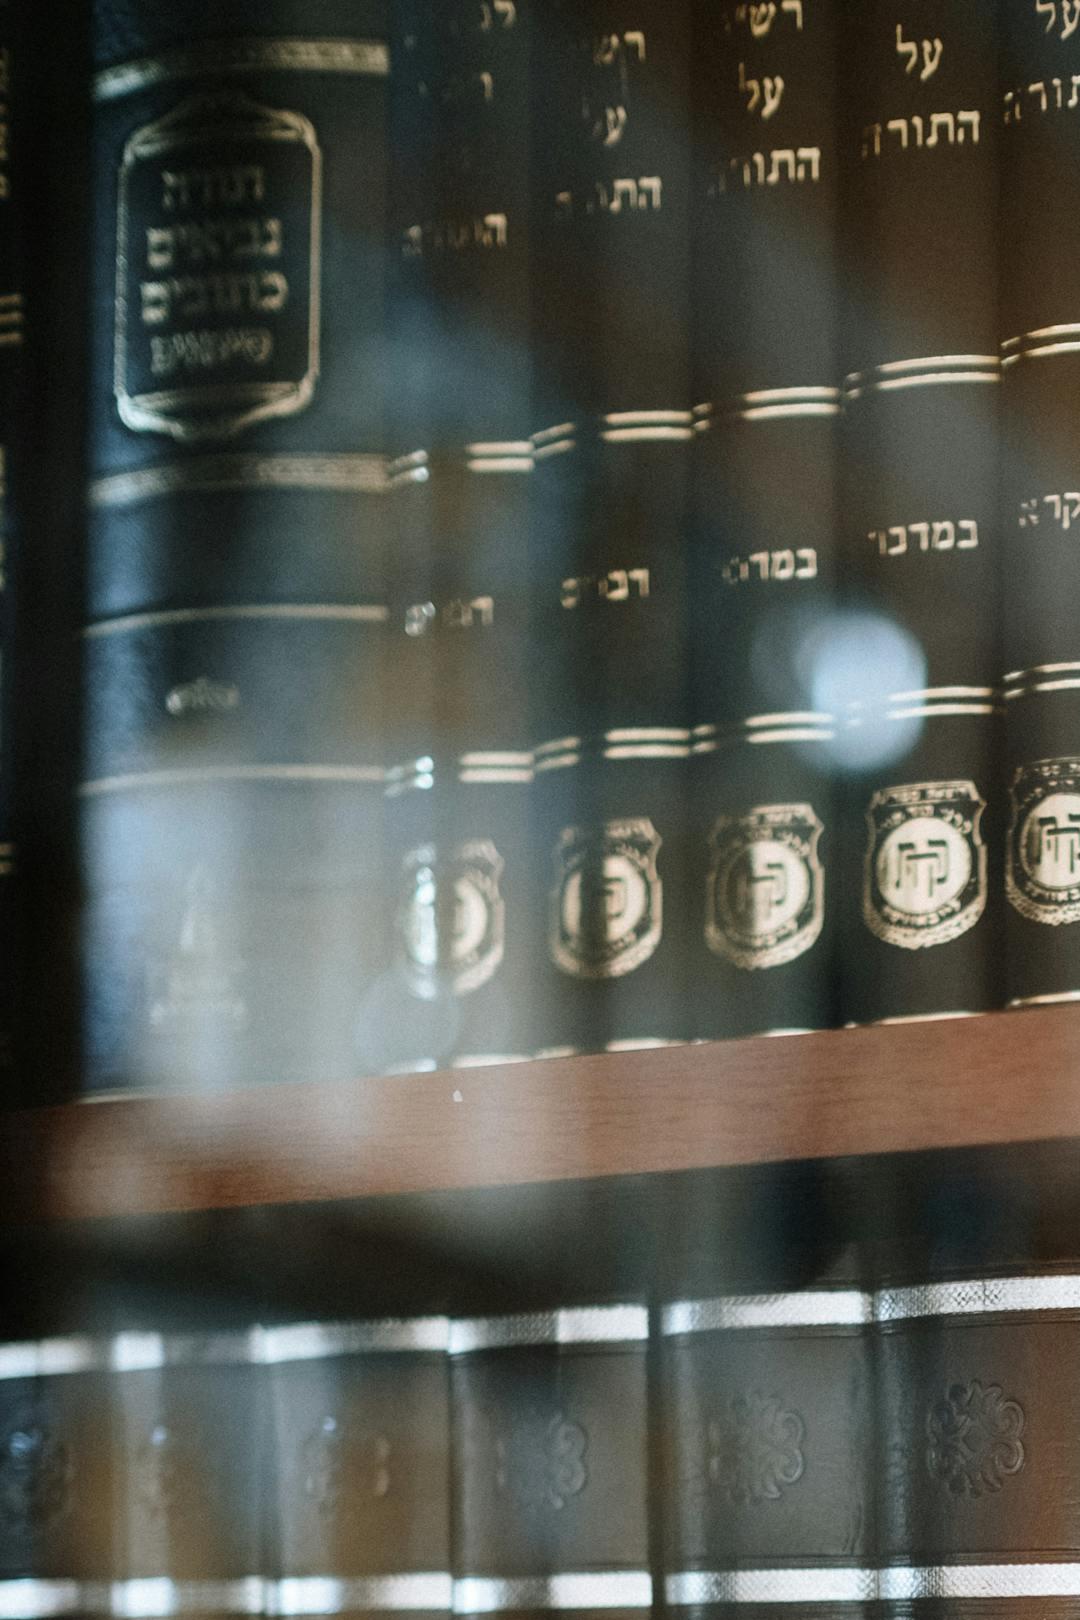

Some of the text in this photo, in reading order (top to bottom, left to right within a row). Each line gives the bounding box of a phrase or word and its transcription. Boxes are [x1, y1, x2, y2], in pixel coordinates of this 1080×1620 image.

[896, 24, 943, 81] על
[738, 62, 784, 119] על
[707, 147, 821, 195] התו
